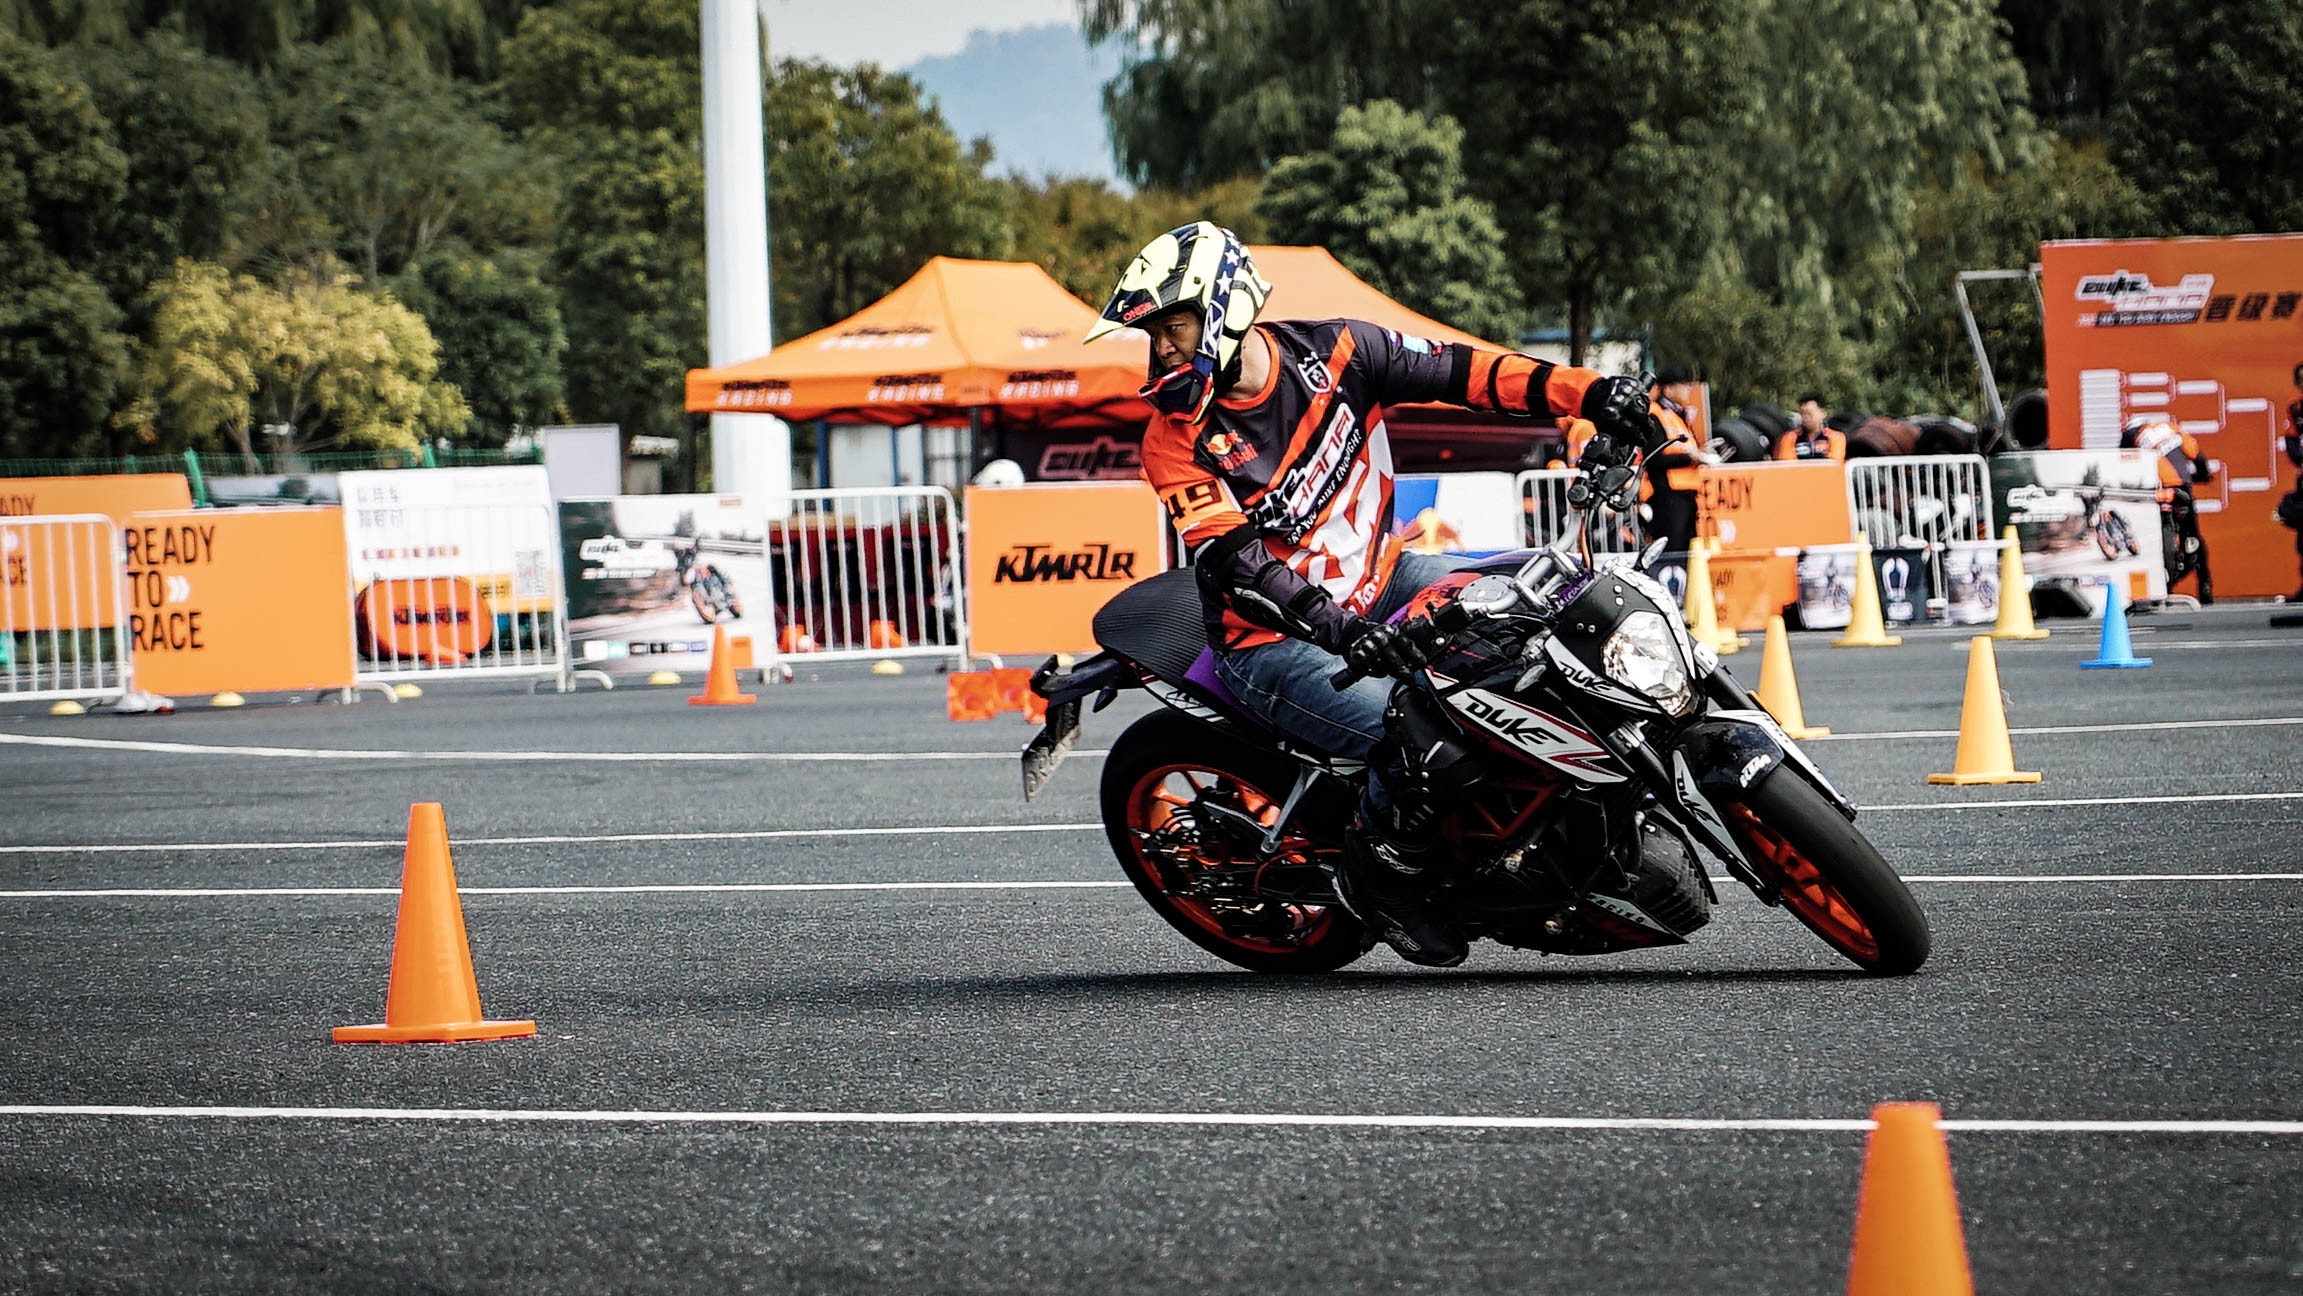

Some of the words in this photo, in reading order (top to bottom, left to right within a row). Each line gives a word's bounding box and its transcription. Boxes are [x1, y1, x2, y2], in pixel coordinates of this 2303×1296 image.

[126, 525, 216, 566] READY
[128, 571, 164, 608] TO
[130, 612, 205, 651] RACE
[1558, 661, 1616, 692] DUKE
[1465, 692, 1568, 746] DUKE
[1676, 769, 1722, 828] DUKE
